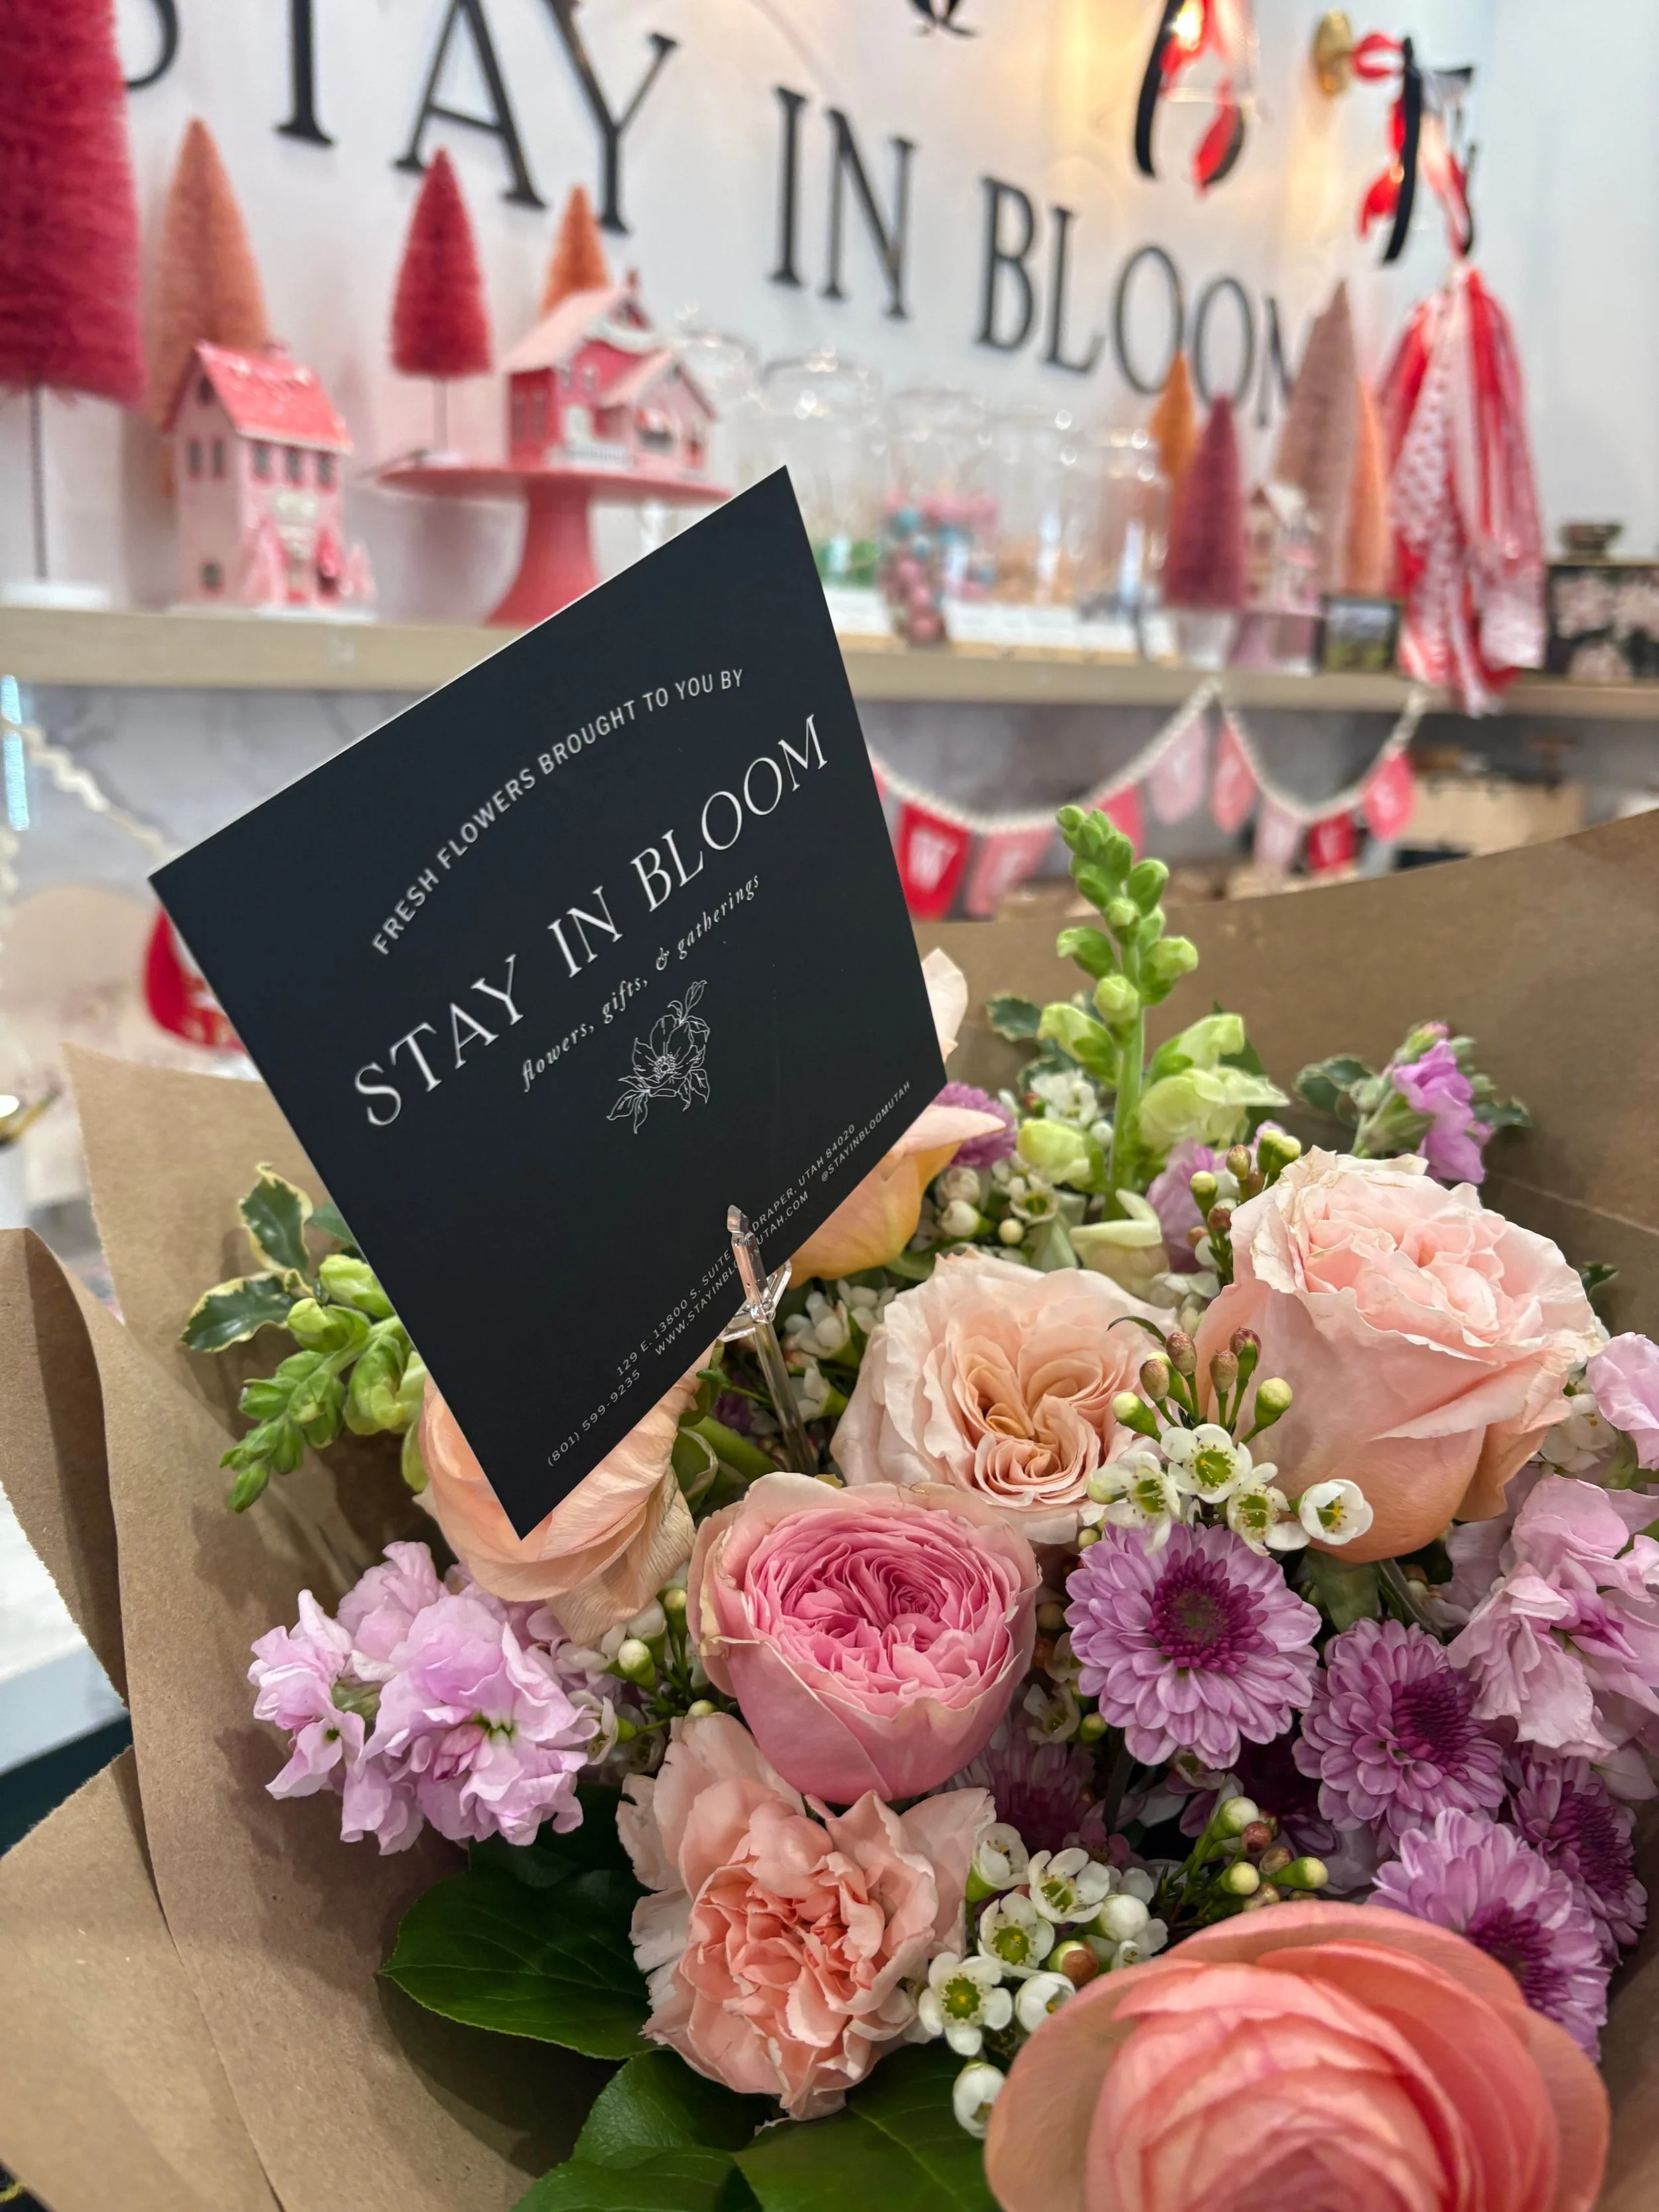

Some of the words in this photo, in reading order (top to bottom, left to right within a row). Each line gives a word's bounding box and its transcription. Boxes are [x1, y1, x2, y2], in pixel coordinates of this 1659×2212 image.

[768, 86, 918, 321] IN
[354, 954, 524, 1126] STAY
[547, 885, 623, 978] IN
[629, 713, 828, 913] BLOOM
[372, 868, 439, 954] FRESH
[437, 768, 536, 869] FLOWERS
[538, 700, 635, 774] BROUGHT
[642, 687, 669, 711] TO
[675, 673, 713, 700] YOU
[720, 668, 743, 690] BY
[522, 1023, 595, 1093] flowers,
[602, 977, 649, 1025] gifts,
[655, 946, 670, 971] &
[678, 875, 760, 960] gatherings
[547, 1432, 580, 1467] (801)
[582, 1369, 640, 1431] 599-9235
[655, 1191, 808, 1355] WWW.STAYINBLUTAH.COM
[821, 1081, 910, 1183] @STAYINBLOOMUTAH
[616, 1352, 638, 1376] 129
[640, 1339, 652, 1352] E.
[654, 1299, 687, 1339] 13800
[690, 1288, 701, 1299] S.
[702, 1249, 731, 1286] SUITE
[798, 1156, 824, 1187] UTAH
[826, 1124, 855, 1159] 84020
